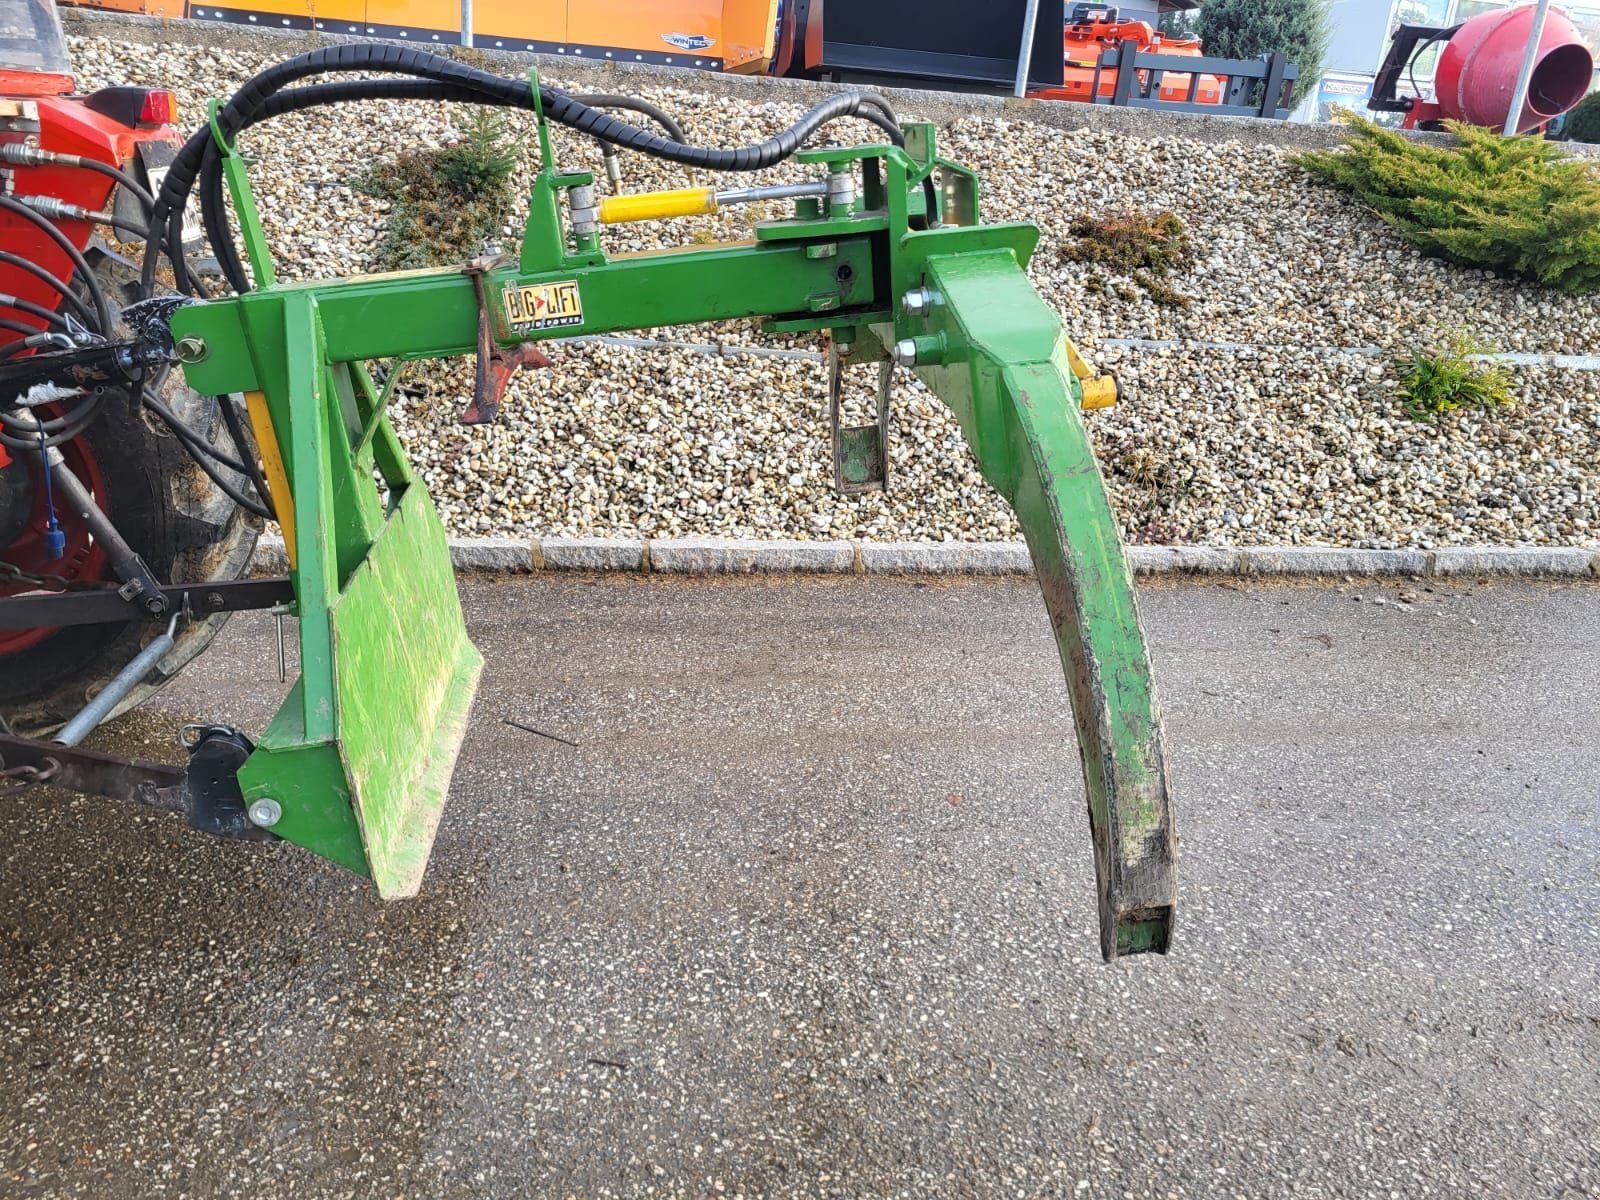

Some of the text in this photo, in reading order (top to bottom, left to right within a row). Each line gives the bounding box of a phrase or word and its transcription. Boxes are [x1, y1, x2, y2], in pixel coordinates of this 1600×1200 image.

[672, 37, 706, 46] WINTEC
[508, 286, 577, 319] BIG LIFT
